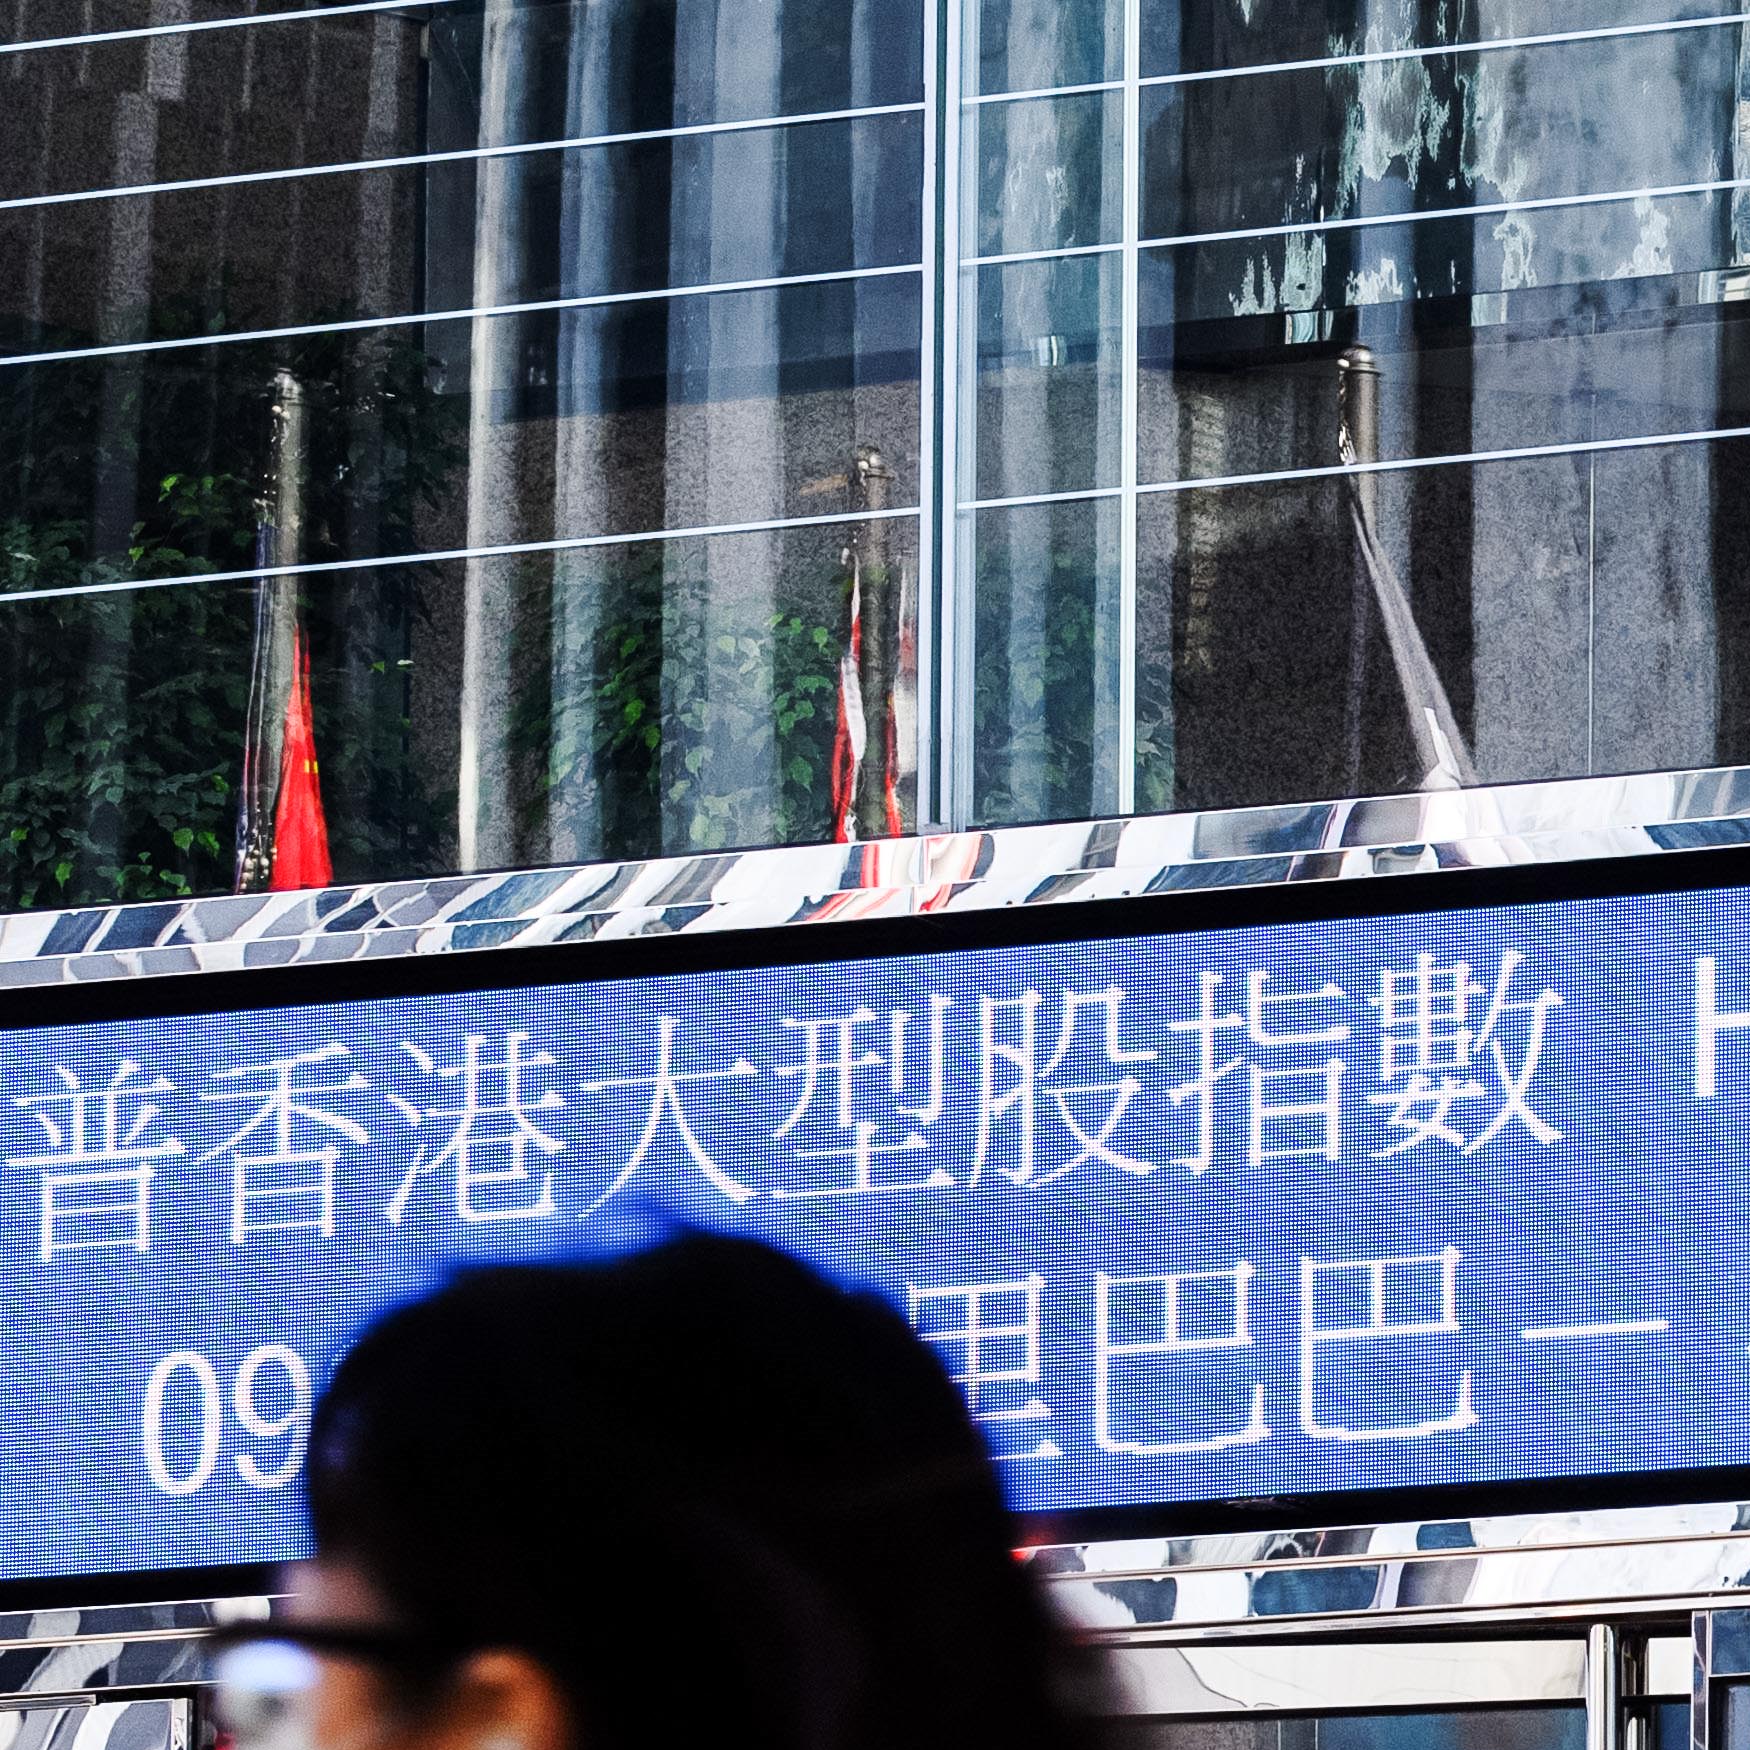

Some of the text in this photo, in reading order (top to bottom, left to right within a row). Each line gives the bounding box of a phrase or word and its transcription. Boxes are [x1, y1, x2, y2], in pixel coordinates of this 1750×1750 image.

[6, 947, 1565, 1264] 普香港大型股指數
